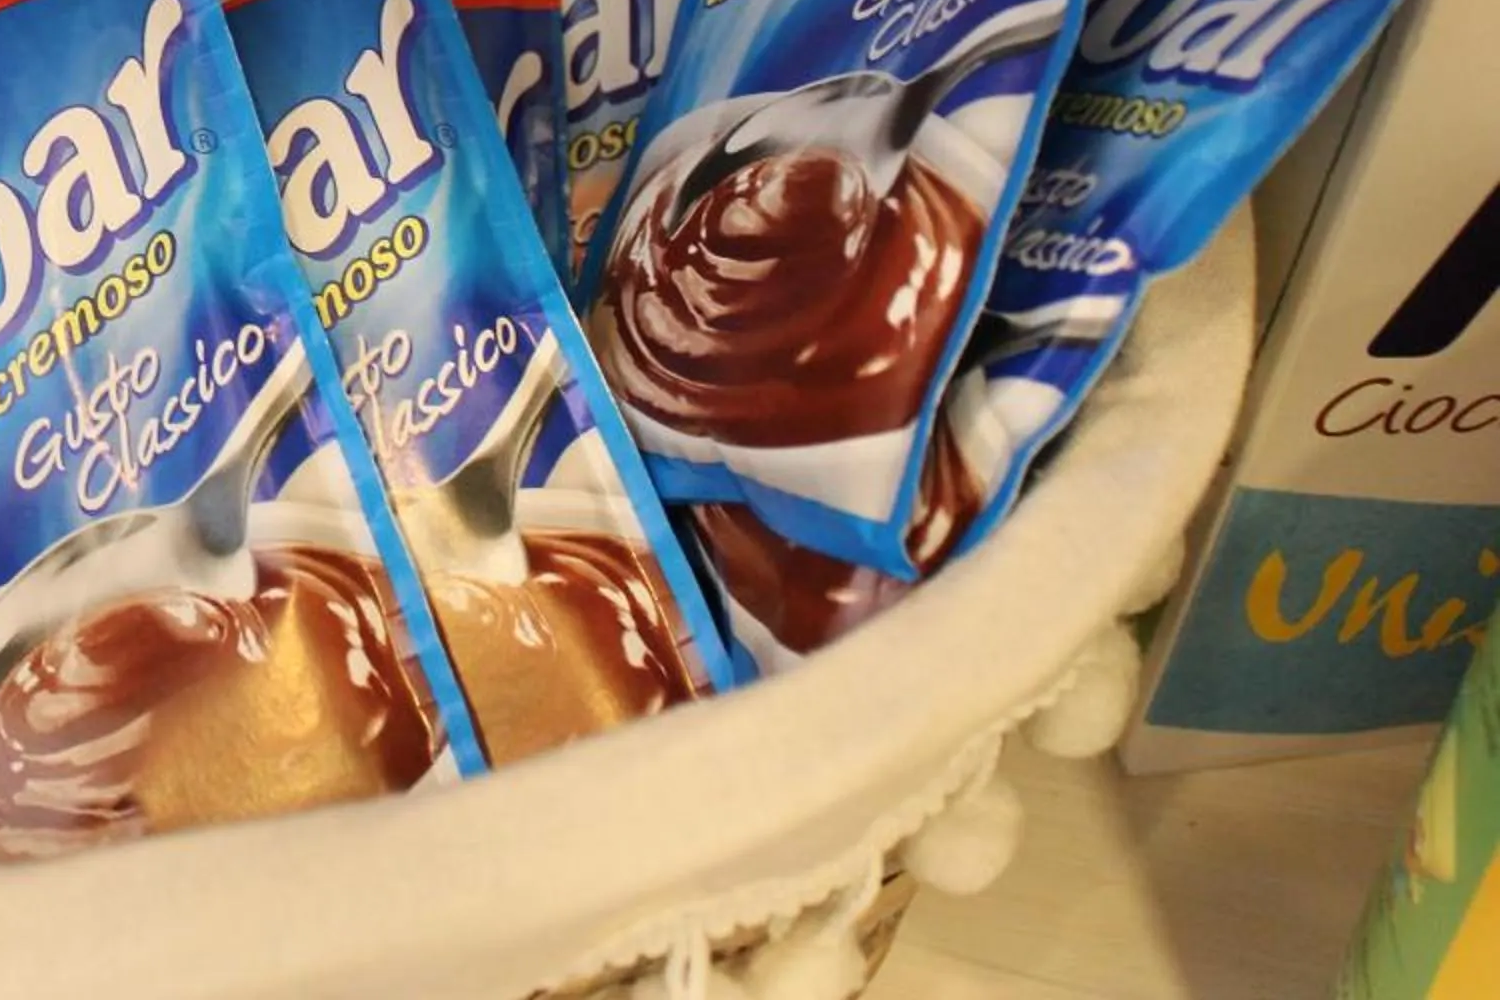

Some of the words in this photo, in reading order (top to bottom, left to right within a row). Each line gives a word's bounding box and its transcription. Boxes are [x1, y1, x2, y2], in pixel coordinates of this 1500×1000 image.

[14, 345, 159, 490] Gusto
[77, 323, 266, 512] Classico
[1245, 546, 1500, 658] Uni
